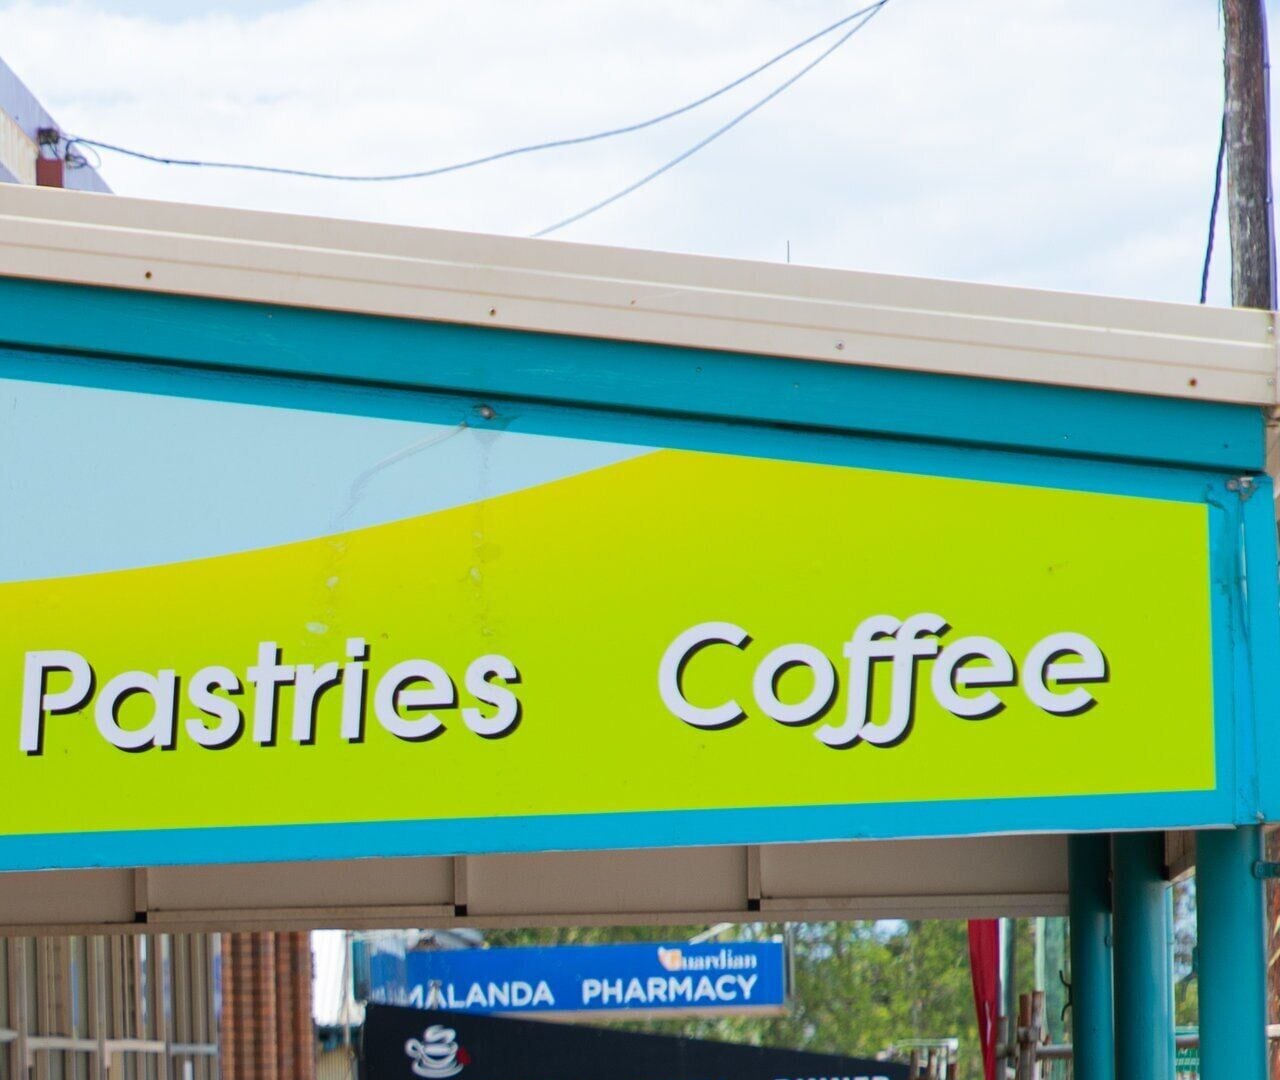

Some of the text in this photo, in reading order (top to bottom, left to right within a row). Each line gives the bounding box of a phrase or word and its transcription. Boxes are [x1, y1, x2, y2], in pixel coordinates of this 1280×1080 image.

[18, 638, 524, 756] Pastries
[658, 612, 1108, 749] Coffee
[657, 946, 758, 971] Guardian
[581, 974, 758, 1006] PHARMACY
